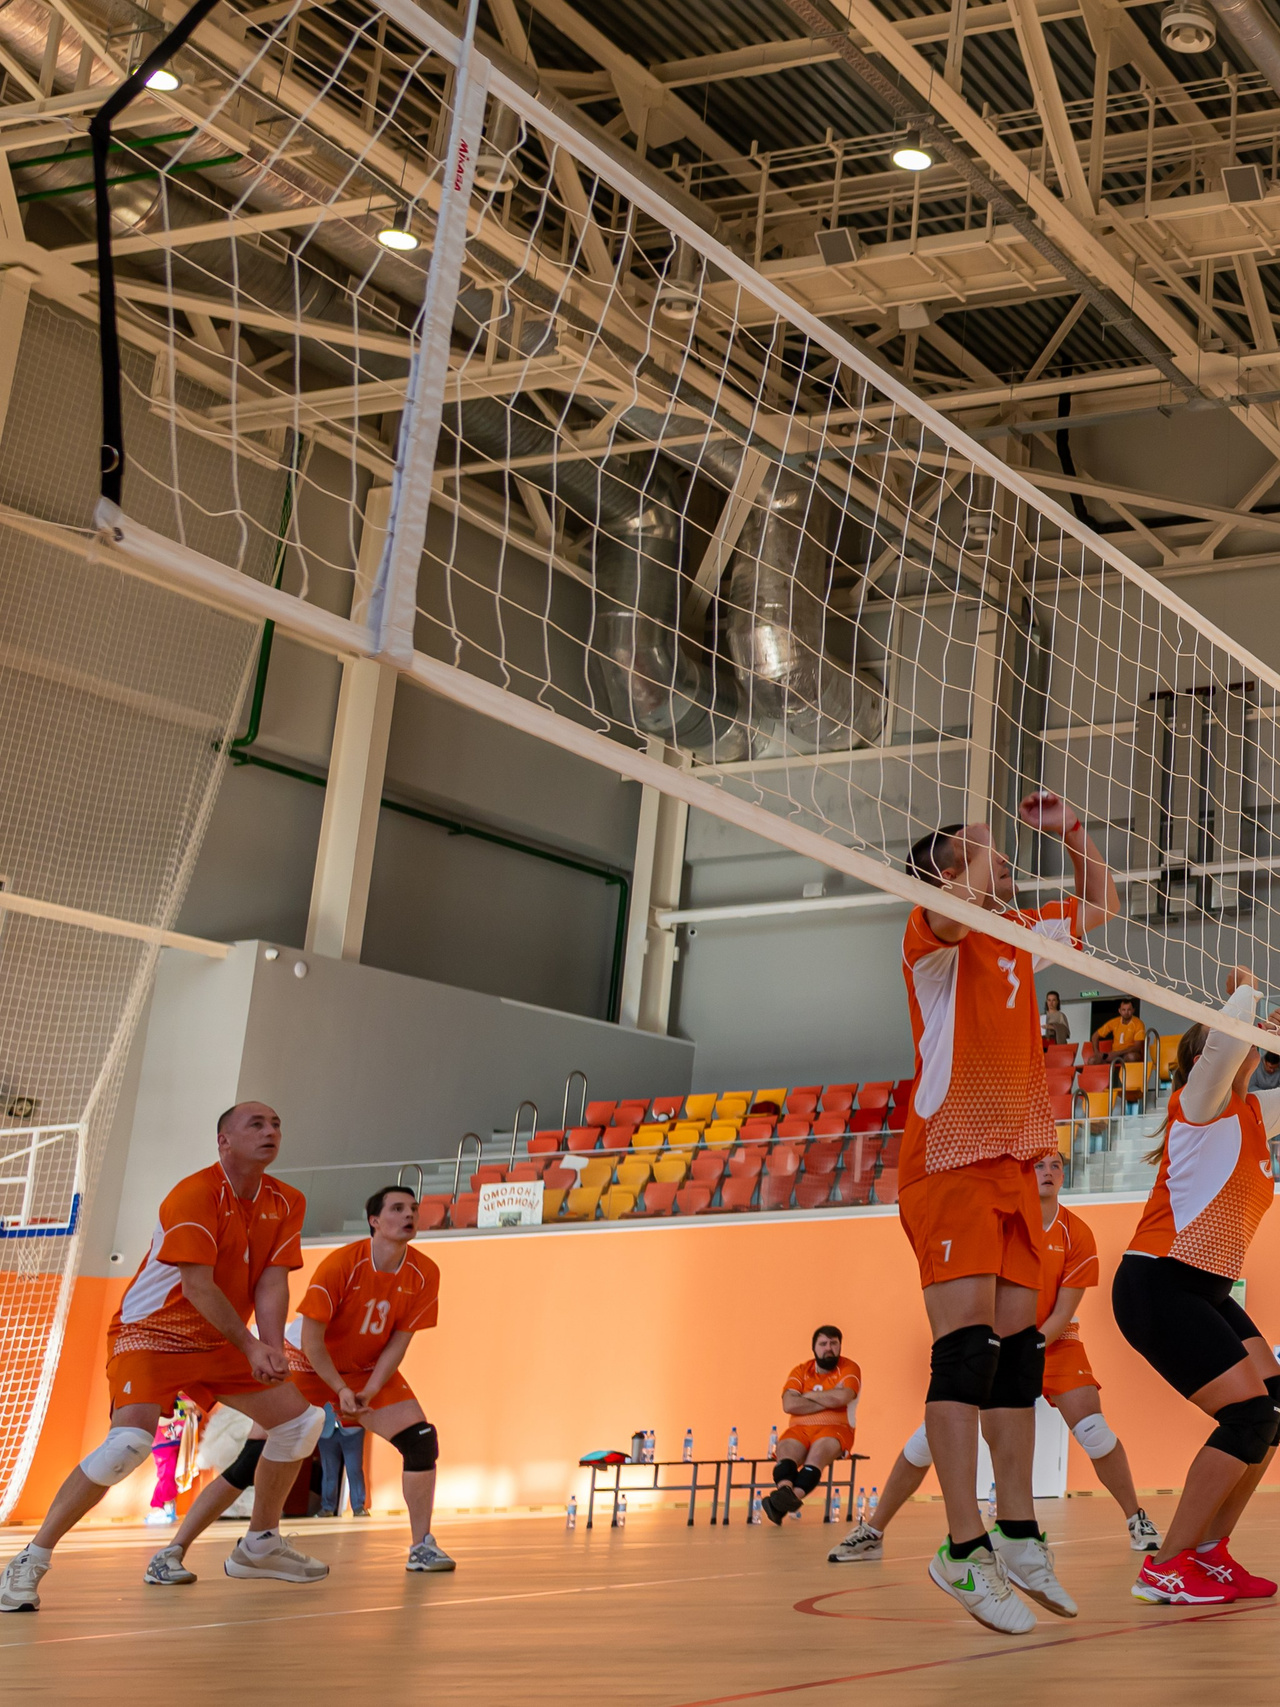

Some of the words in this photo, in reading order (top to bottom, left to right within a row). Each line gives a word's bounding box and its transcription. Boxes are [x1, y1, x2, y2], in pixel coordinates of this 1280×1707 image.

[997, 956, 1020, 1009] 7
[941, 1239, 952, 1262] 7
[360, 1298, 391, 1335] 13
[123, 1381, 131, 1394] 4
